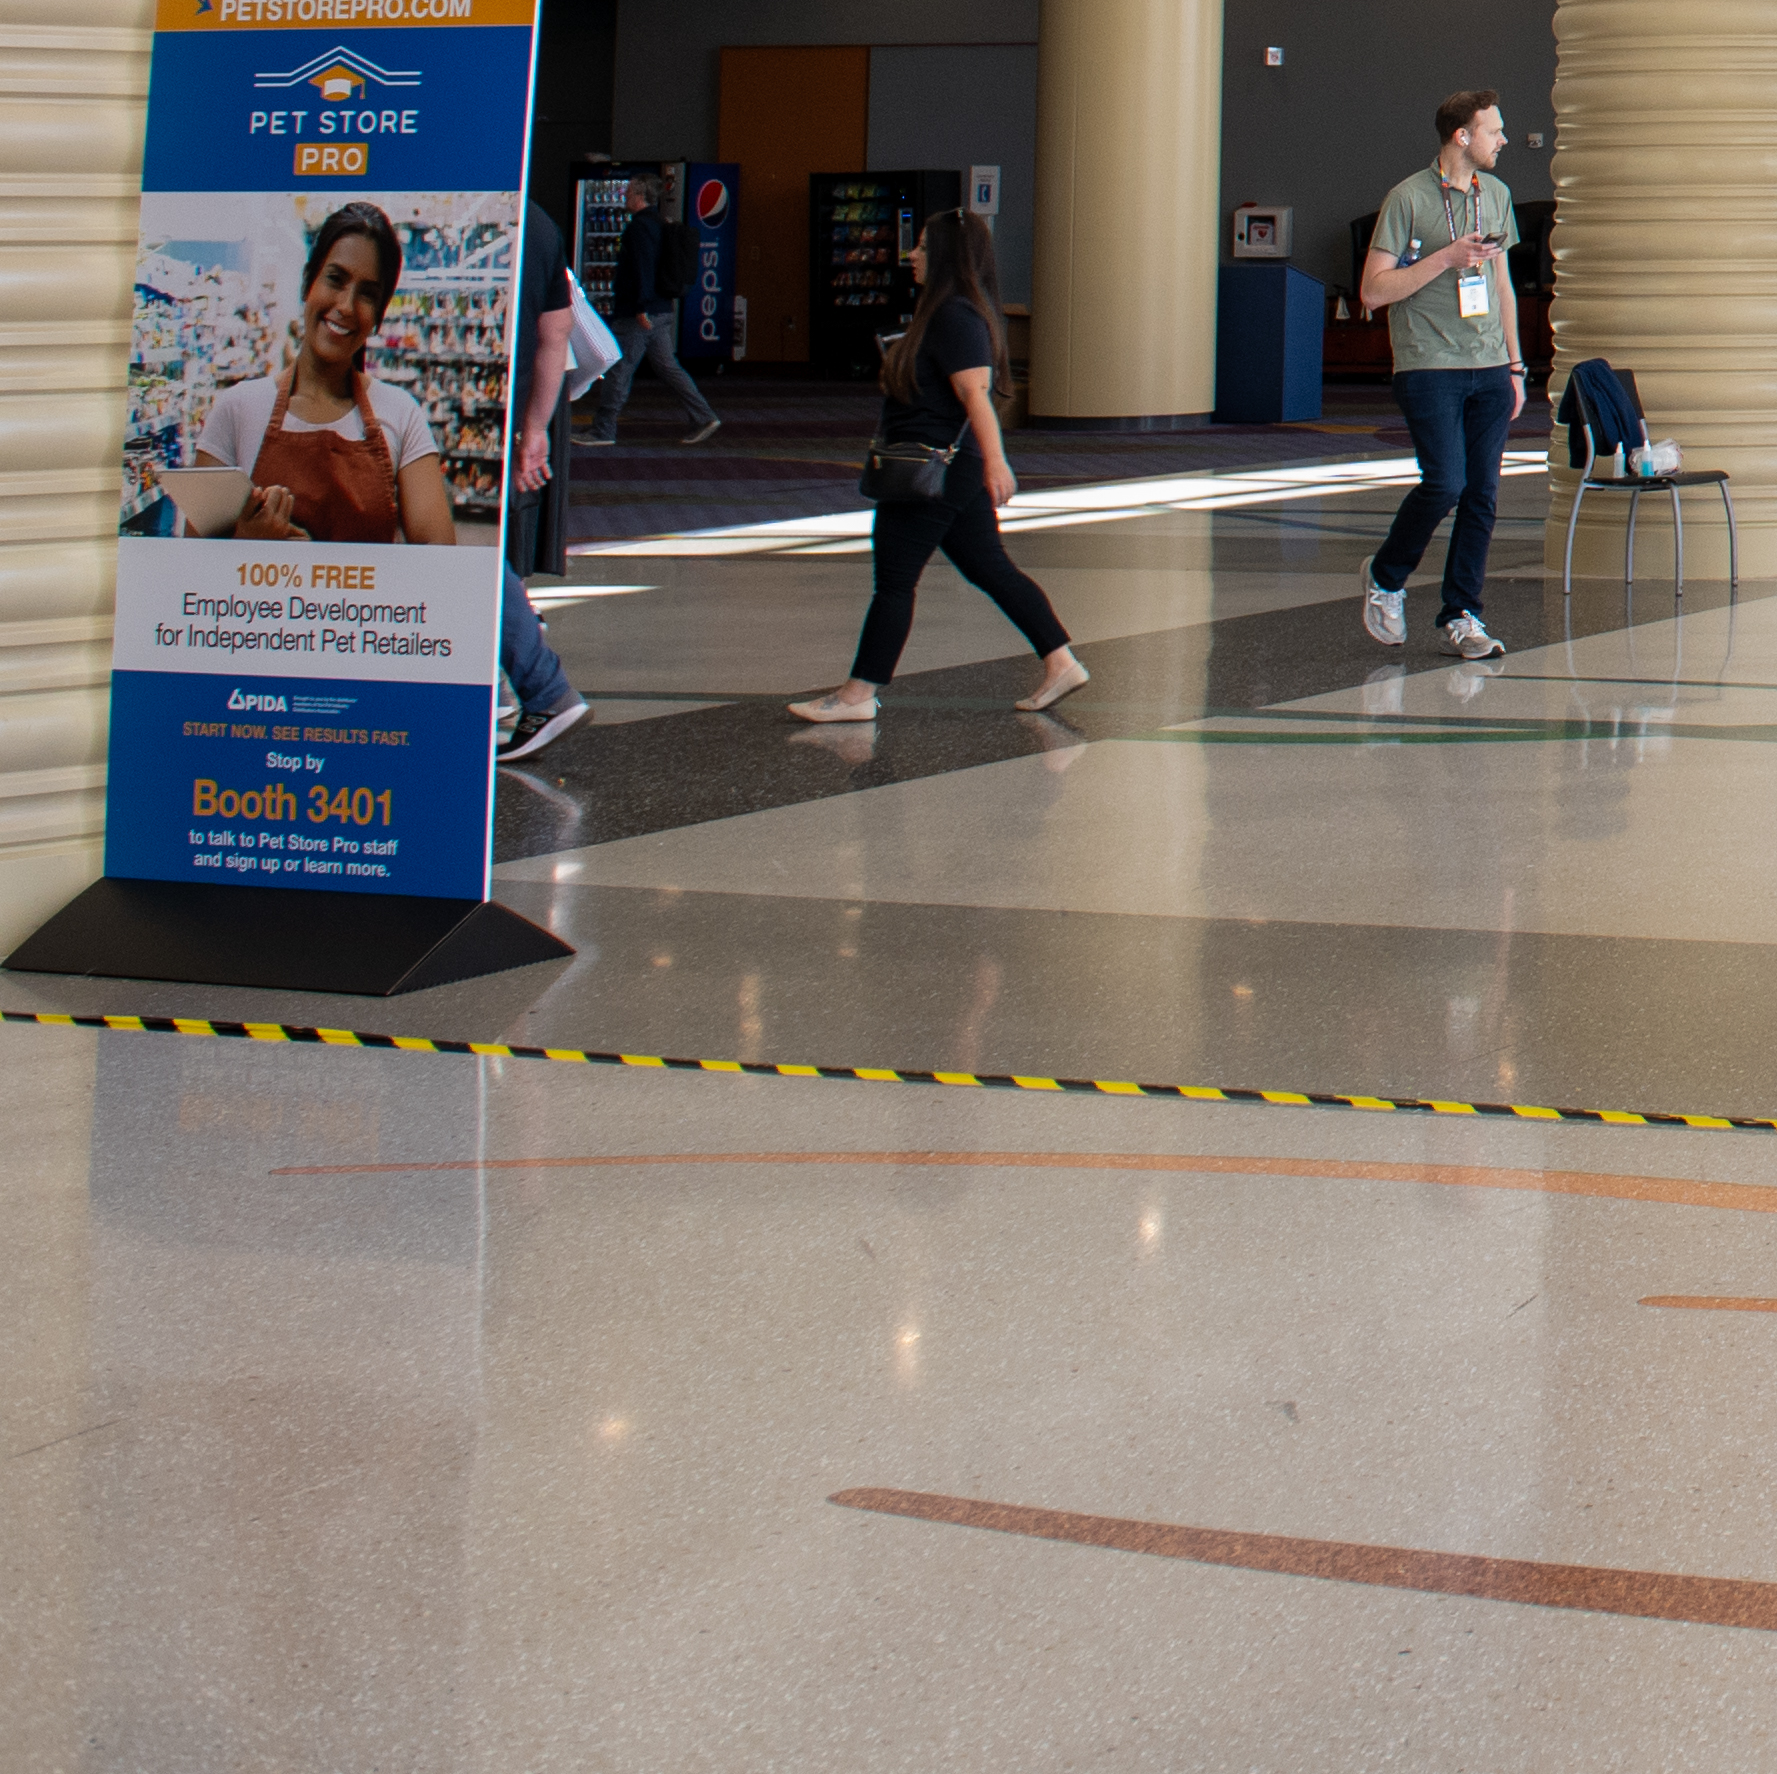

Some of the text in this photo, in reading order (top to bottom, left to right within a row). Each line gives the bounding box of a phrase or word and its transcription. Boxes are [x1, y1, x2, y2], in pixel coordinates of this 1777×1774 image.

[250, 110, 420, 134] PET STORE
[302, 147, 363, 172] PRO
[700, 240, 722, 342] pepsi
[236, 562, 376, 590] 100% FREE
[183, 592, 427, 627] Employee Development
[155, 623, 452, 658] for Independent Pet Retailers
[245, 694, 288, 714] PIDA
[182, 721, 410, 746] START NOW. SEE RESULTS FAST.
[265, 751, 325, 774] Stop by
[192, 778, 393, 826] Booth 3401
[188, 829, 399, 856] to talk to Pet Store Pro staff
[193, 852, 391, 878] and sign up or learn more.
